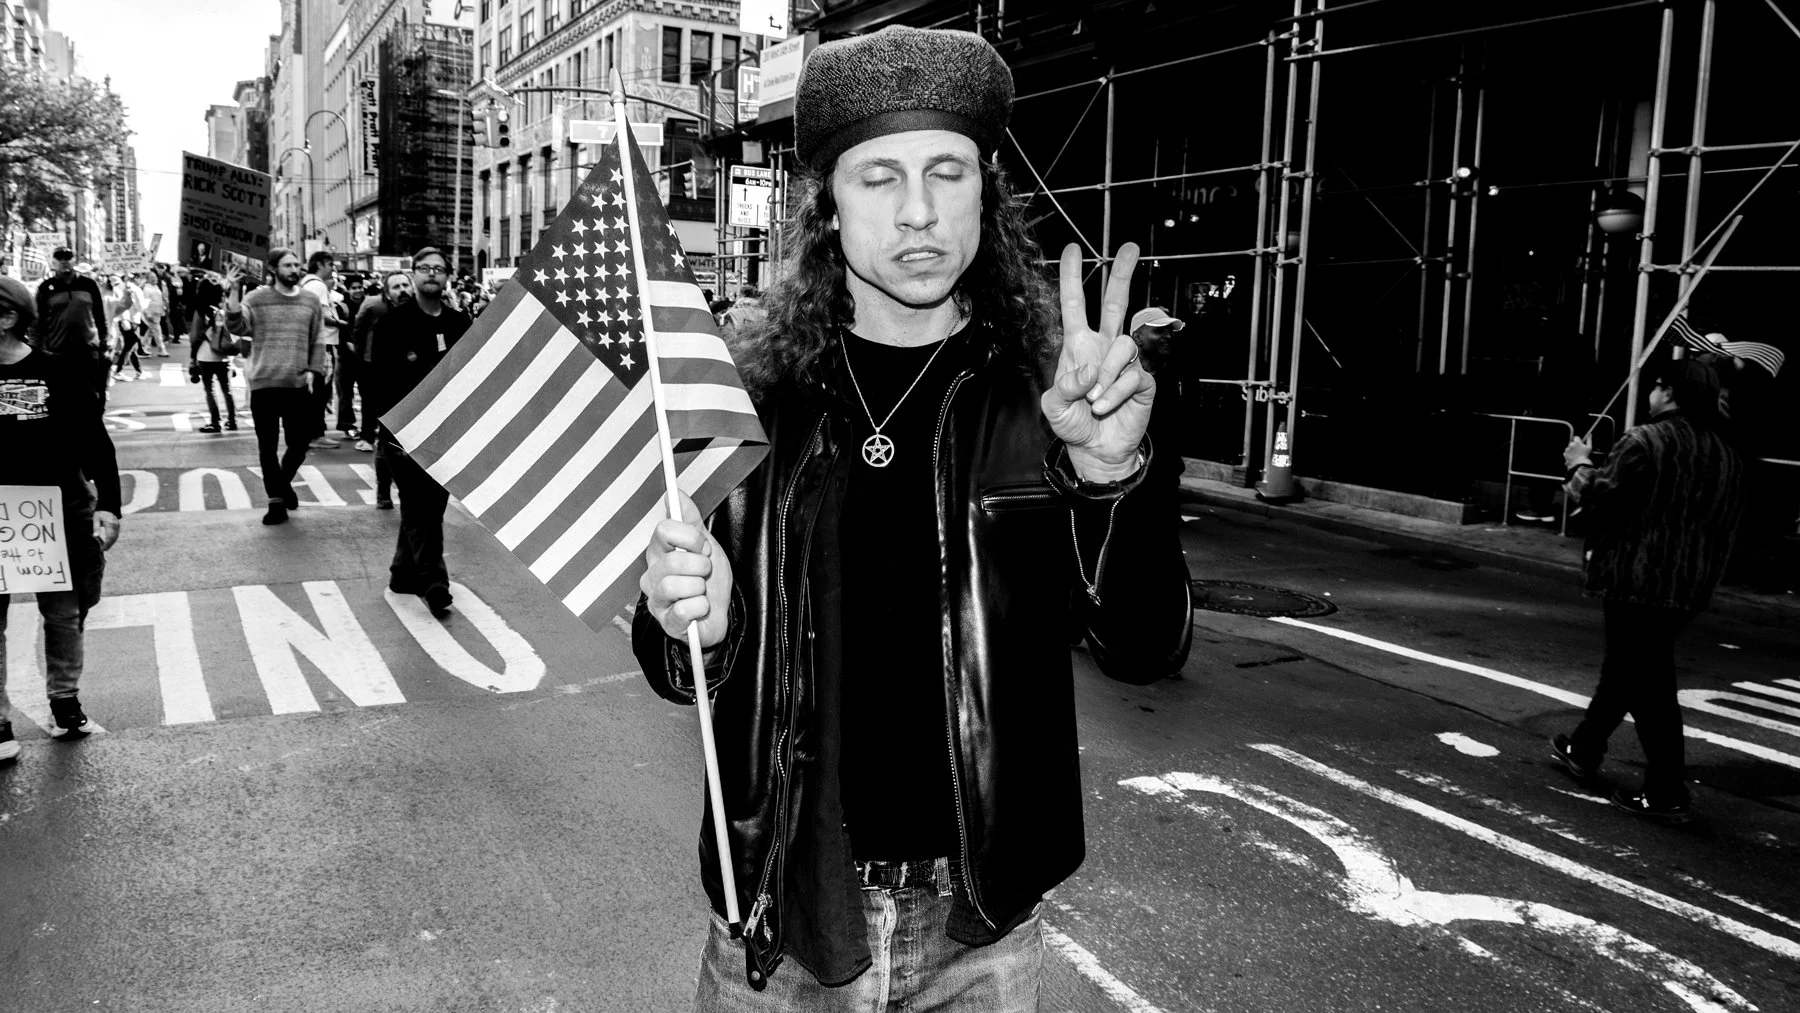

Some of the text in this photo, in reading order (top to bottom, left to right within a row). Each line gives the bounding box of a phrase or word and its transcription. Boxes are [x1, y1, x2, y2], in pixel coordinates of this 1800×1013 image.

[367, 81, 376, 106] Pratt
[369, 112, 379, 137] Pratt
[597, 126, 608, 139] 7
[185, 157, 263, 187] TRUMP ALLY:
[744, 169, 755, 177] BUS
[184, 174, 267, 208] RICK SCOTT
[183, 213, 209, 231] 3150
[104, 243, 138, 253] LOVE
[18, 498, 54, 520] NO
[21, 522, 57, 544] NO
[26, 548, 45, 561] to
[16, 561, 67, 585] From
